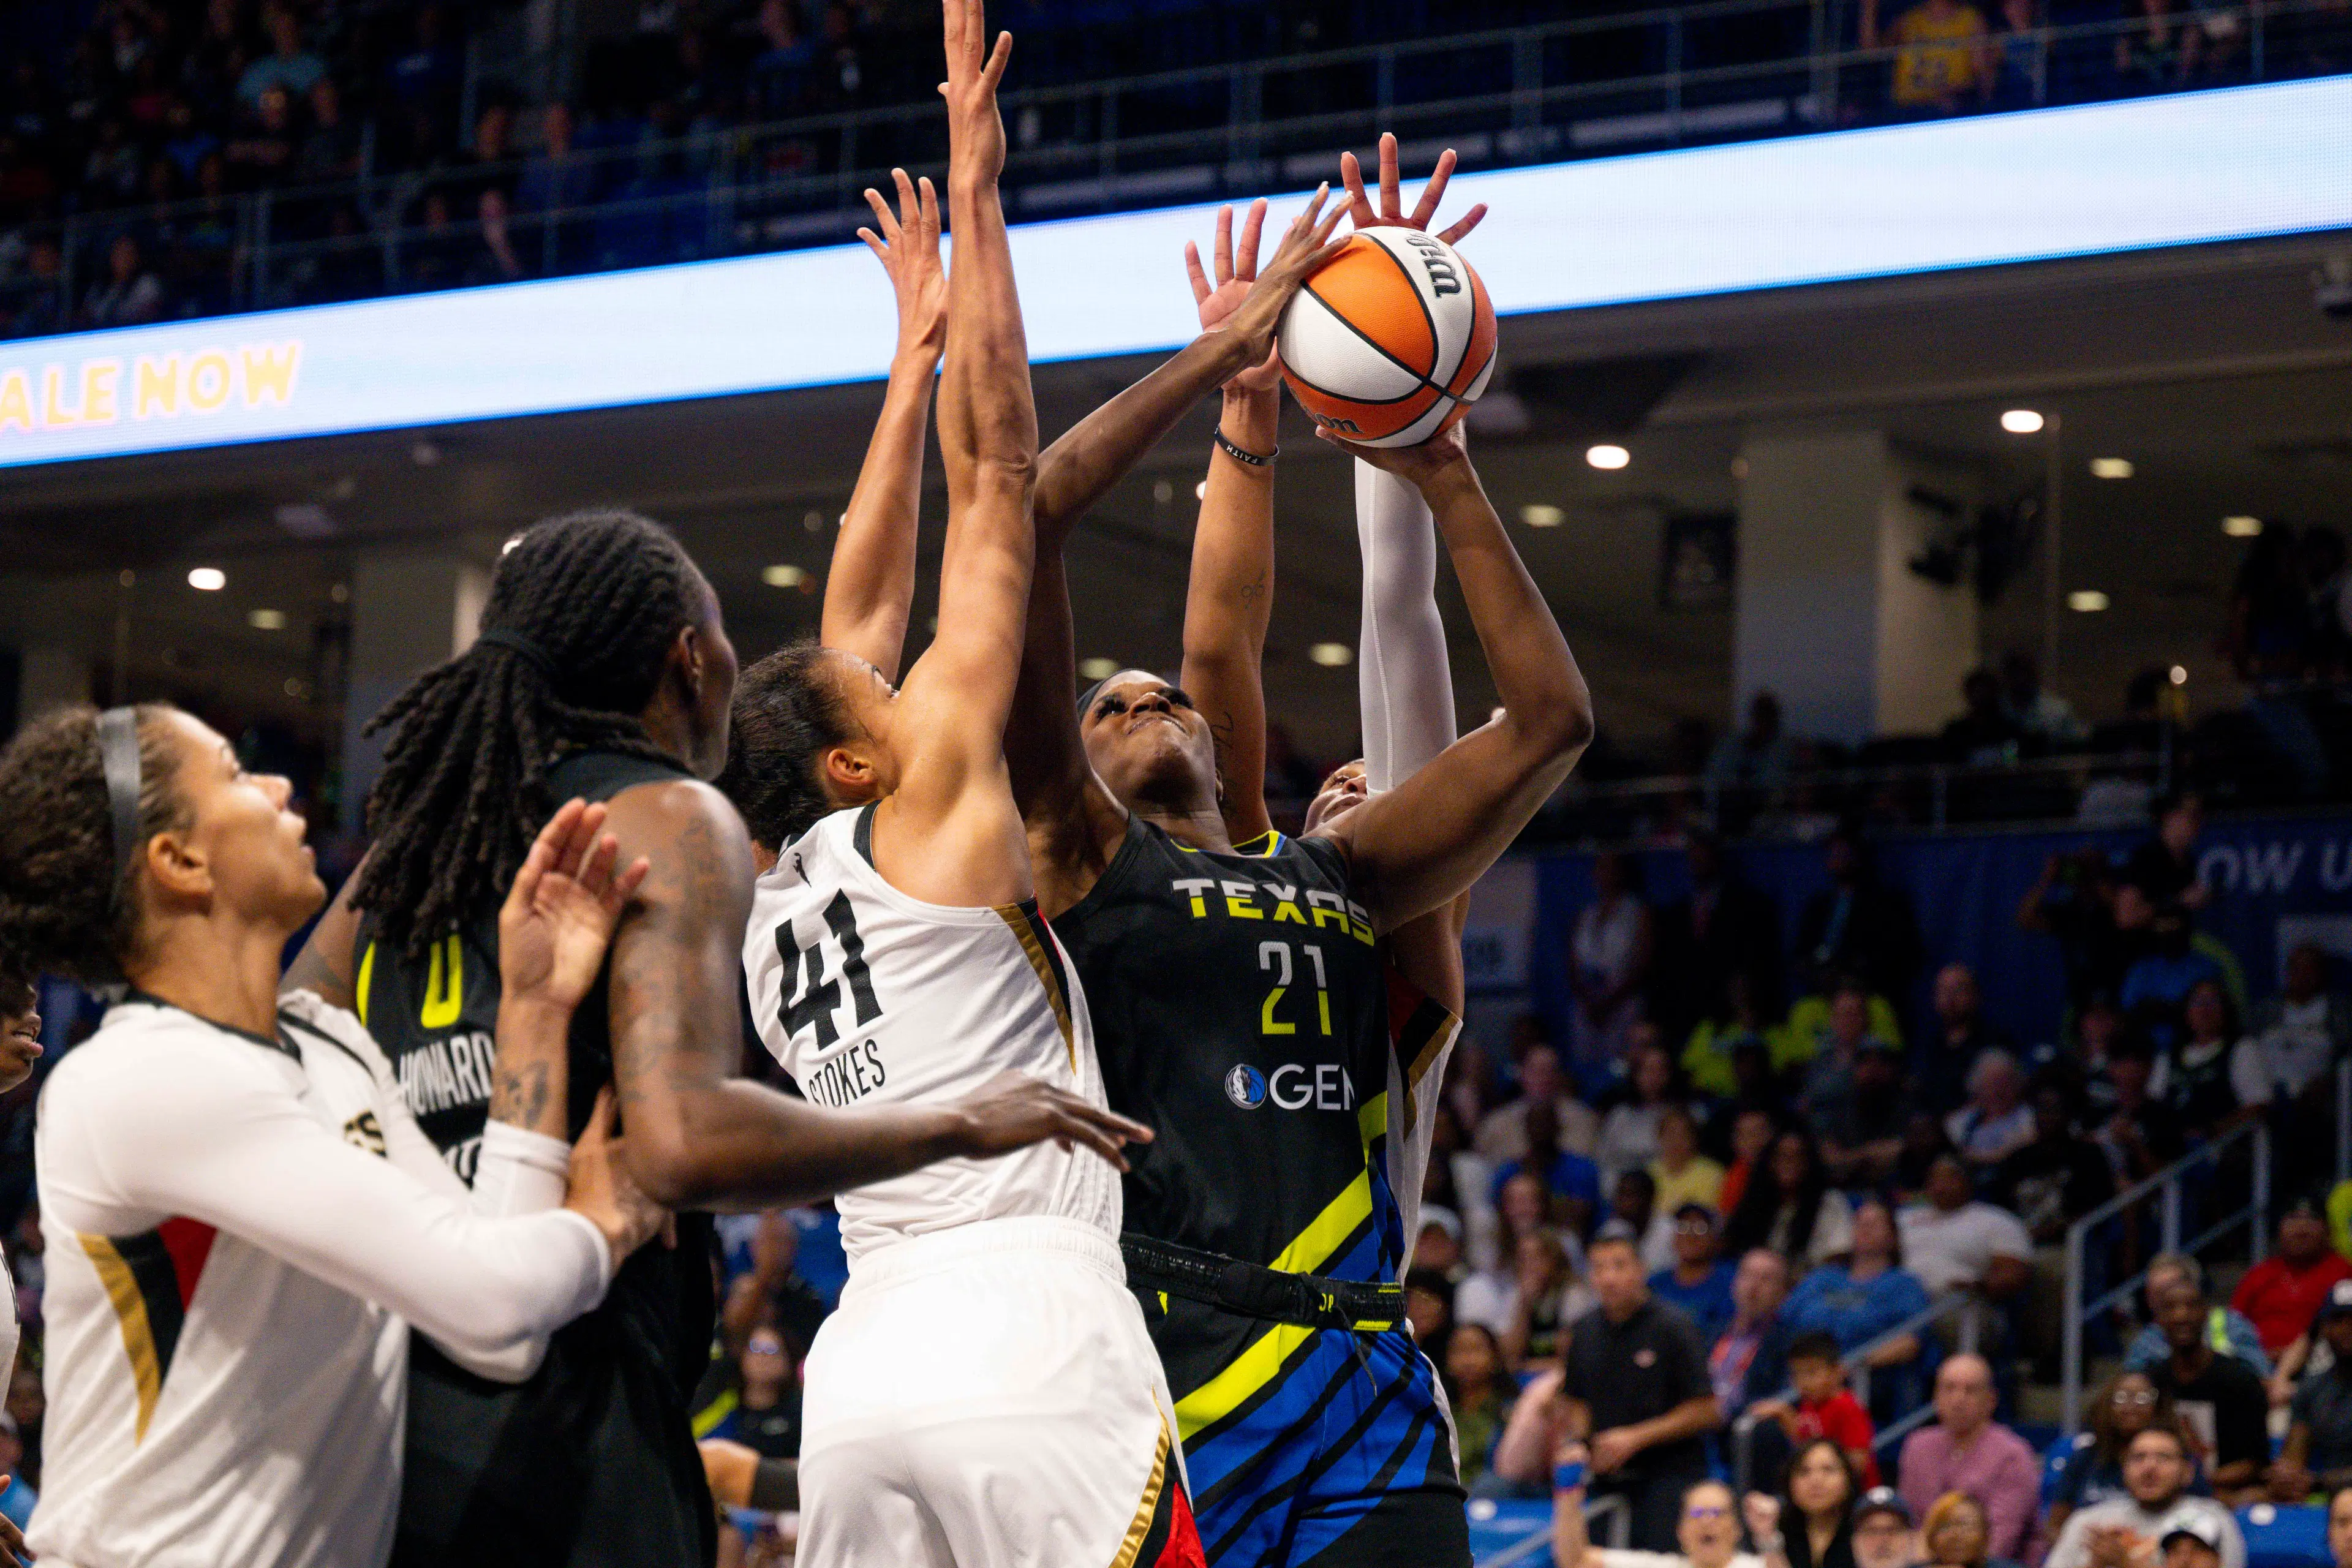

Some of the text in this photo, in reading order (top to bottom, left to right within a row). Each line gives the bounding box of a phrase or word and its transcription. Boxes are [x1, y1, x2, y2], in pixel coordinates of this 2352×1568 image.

[1404, 232, 1461, 298] Wil
[138, 344, 298, 417] NOW
[1226, 444, 1257, 464] FAITH
[1172, 878, 1374, 946] TEXAS
[775, 888, 883, 1052] 41
[1259, 940, 1332, 1036] 21
[399, 1031, 496, 1116] HOWARD
[809, 1039, 886, 1108] STOKES
